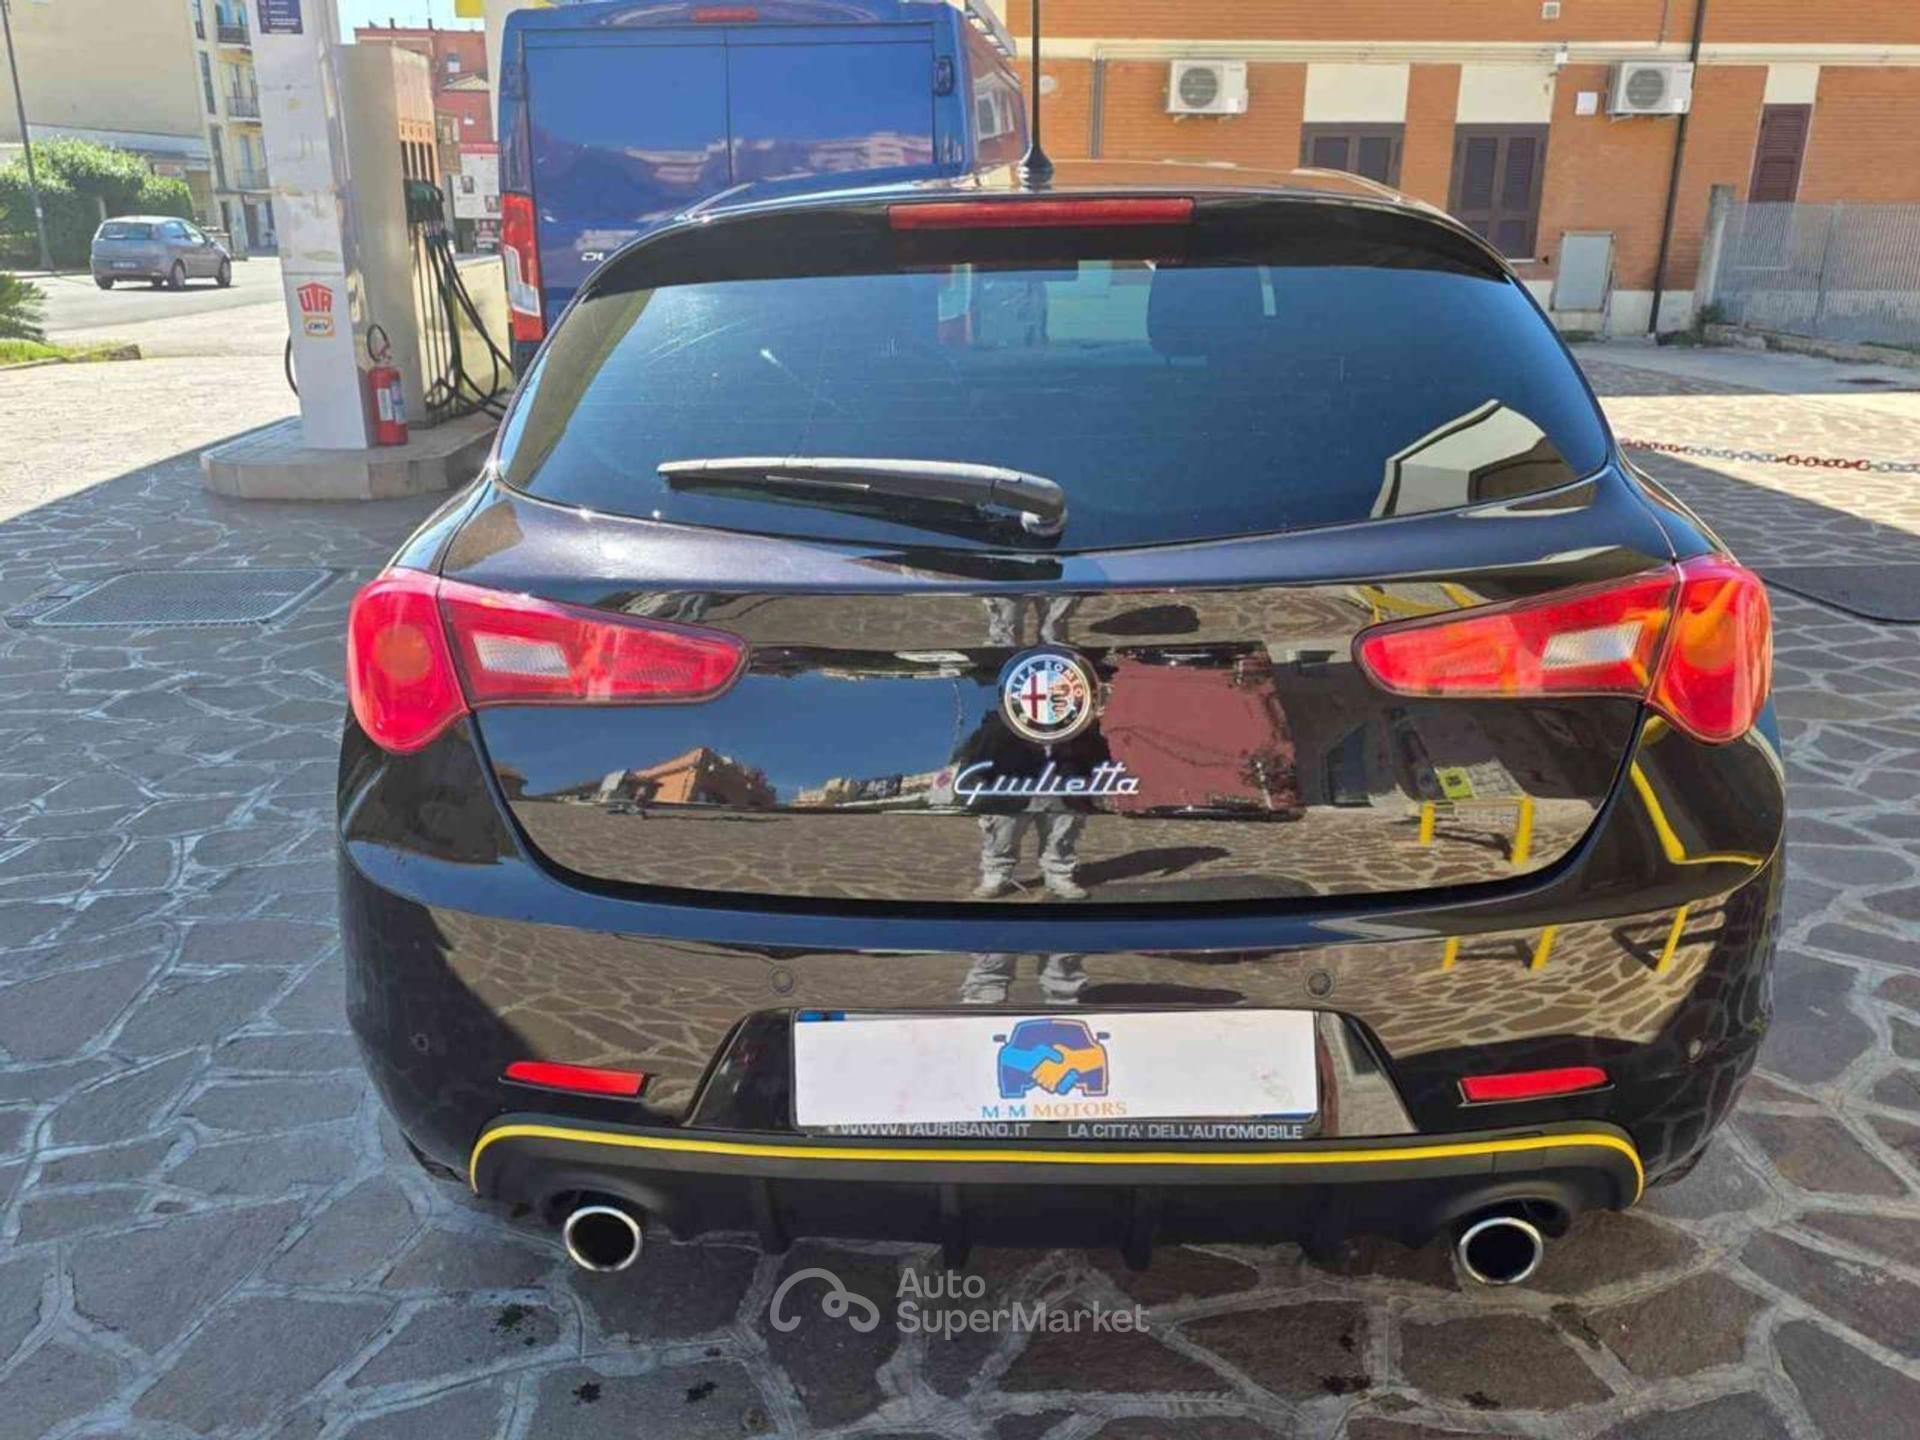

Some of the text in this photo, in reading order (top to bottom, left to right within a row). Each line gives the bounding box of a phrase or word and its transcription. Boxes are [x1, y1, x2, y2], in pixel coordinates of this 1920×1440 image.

[297, 281, 333, 312] UTA
[1010, 660, 1084, 700] ALFA ROMEO
[954, 761, 1140, 805] Giulietta
[1032, 1101, 1128, 1118] MOTORS
[1067, 1123, 1090, 1138] LA
[1149, 1123, 1304, 1139] DELL'AUTOMOBILE
